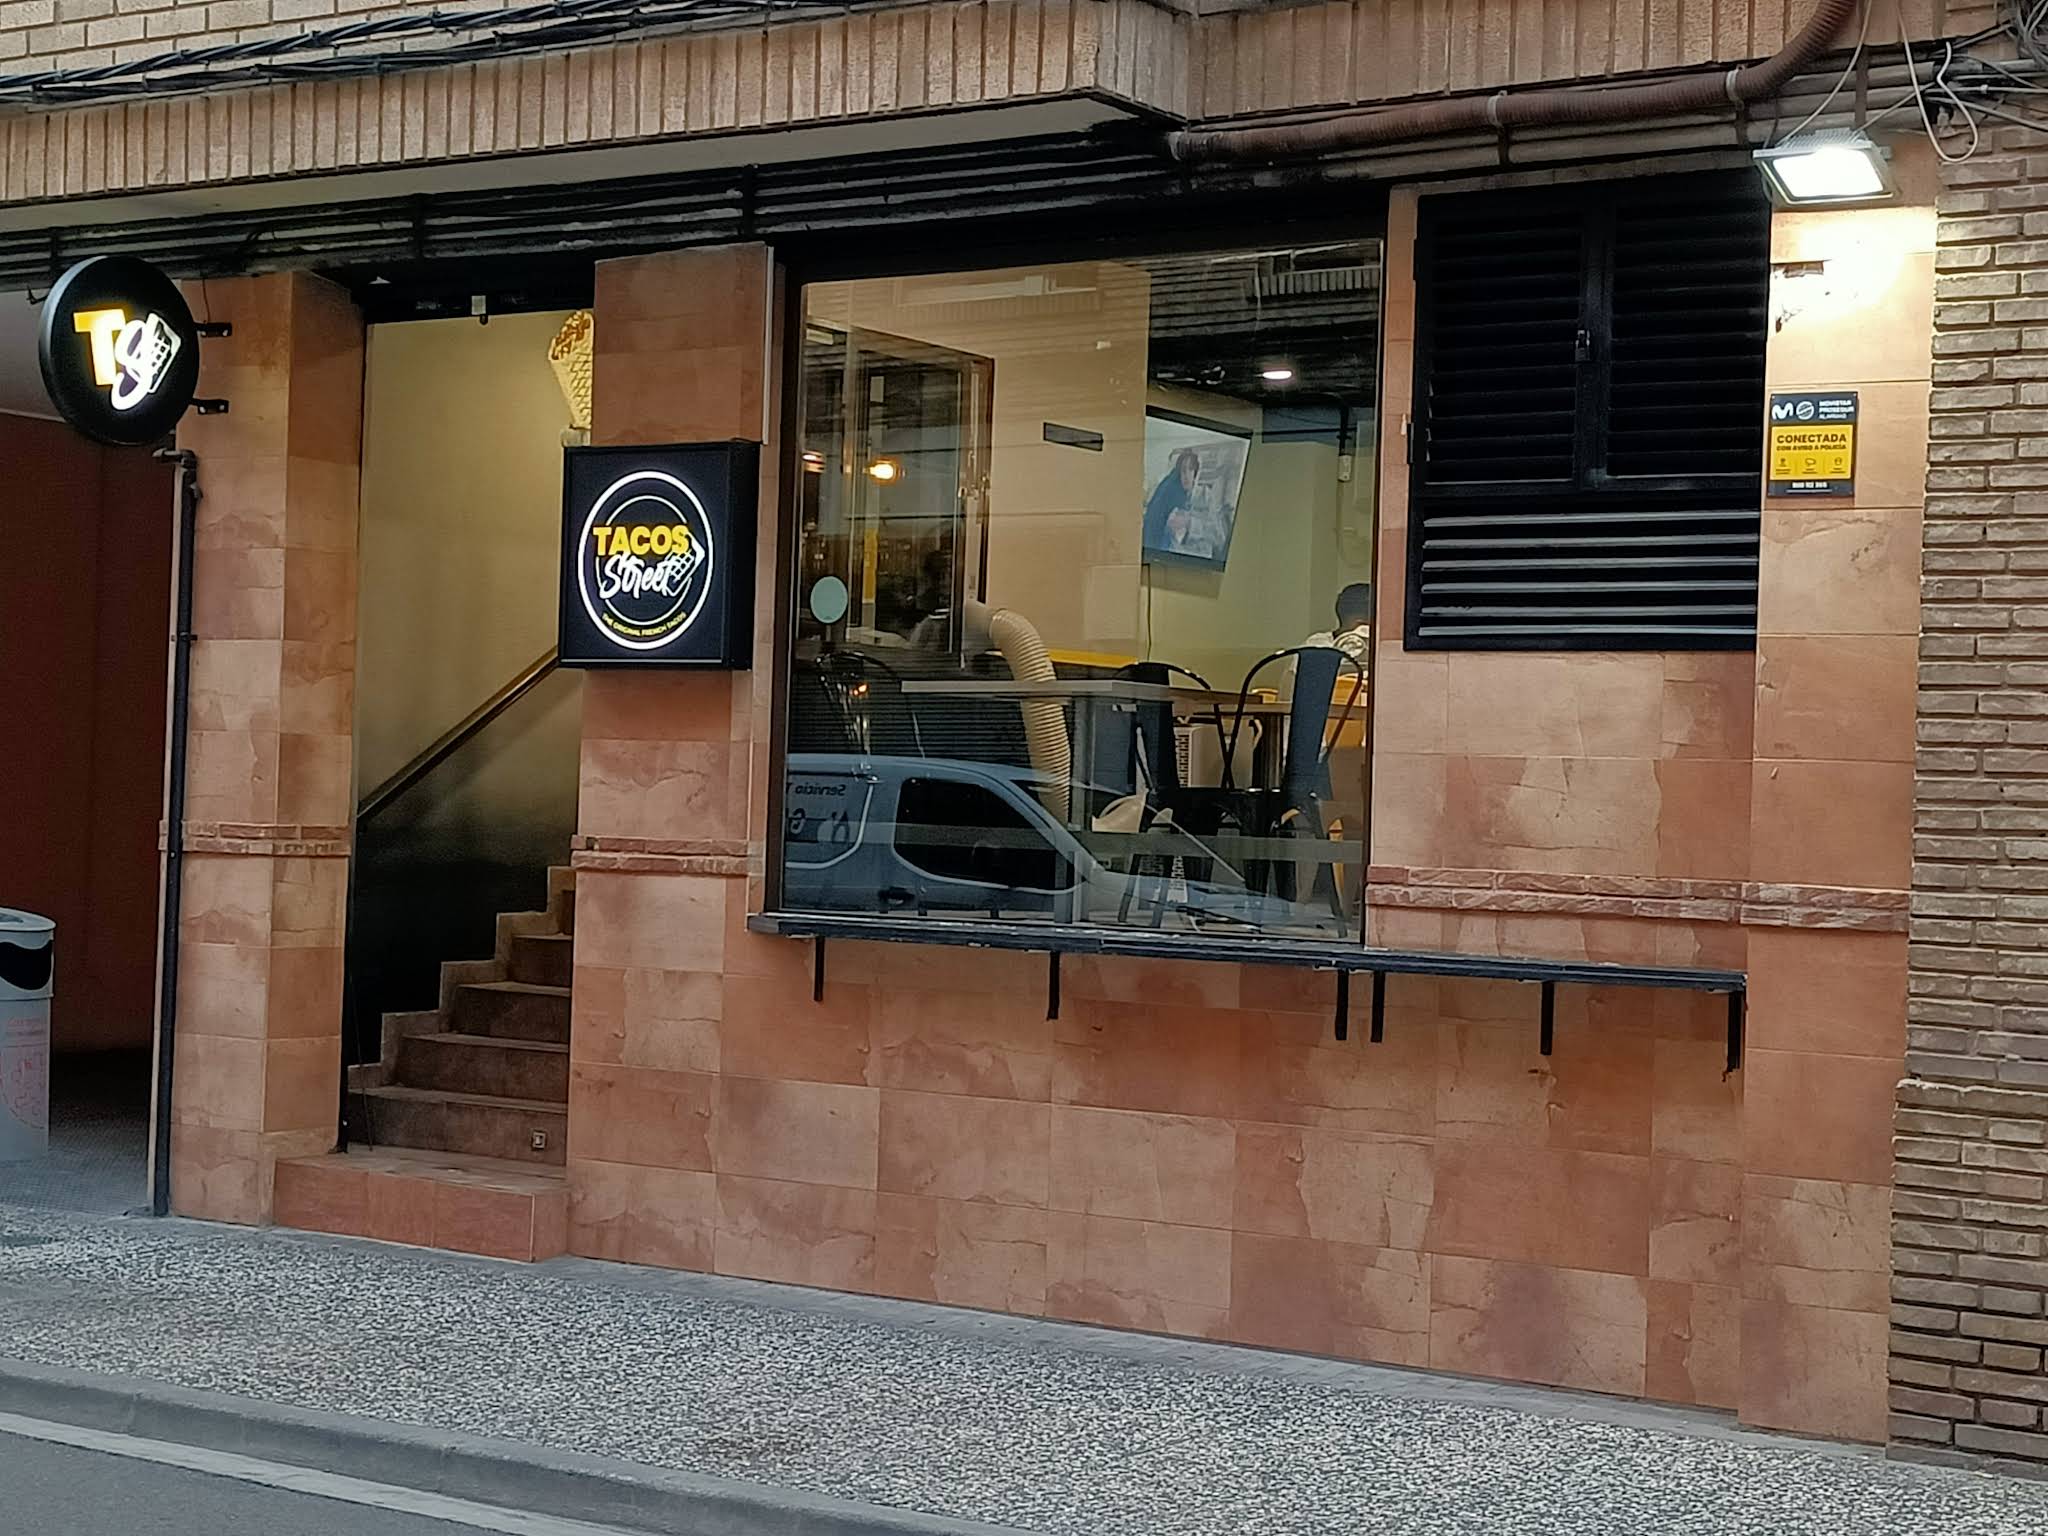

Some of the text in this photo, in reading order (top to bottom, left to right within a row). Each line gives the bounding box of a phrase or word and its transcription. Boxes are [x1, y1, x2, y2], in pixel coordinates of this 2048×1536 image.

[1777, 434, 1846, 443] CONECTADA
[593, 524, 689, 556] TACOS
[599, 551, 678, 600] Street
[601, 612, 687, 636] THE ORIGINAL FRENCH TACOS
